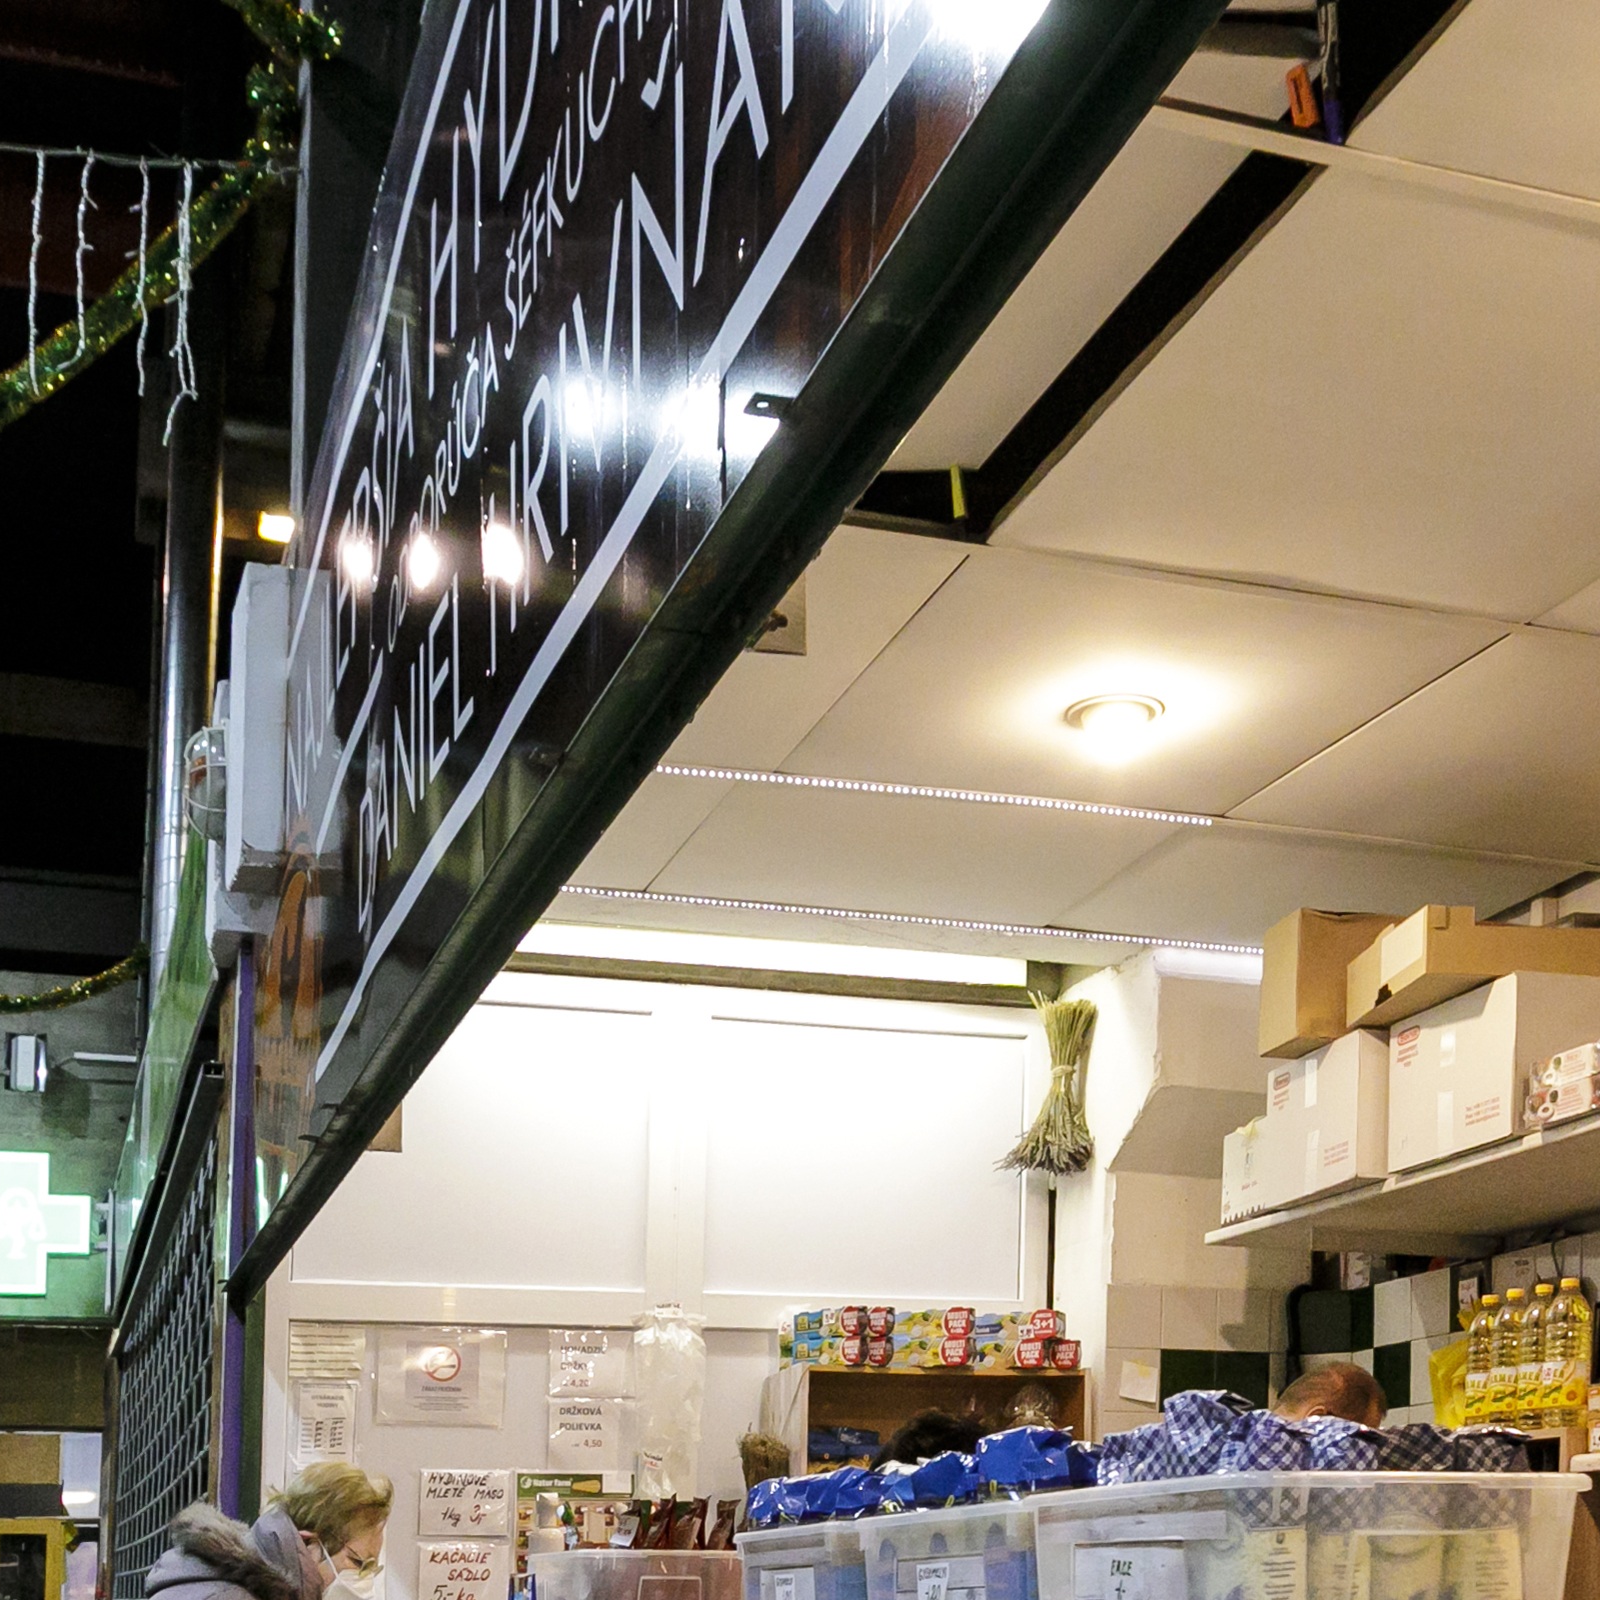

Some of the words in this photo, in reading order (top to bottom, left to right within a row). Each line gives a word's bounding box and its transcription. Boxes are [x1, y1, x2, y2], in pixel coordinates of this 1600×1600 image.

[428, 0, 560, 402] HYD
[503, 0, 652, 361] ŠÉFKUCH
[358, 570, 474, 932] DANIEL
[559, 1406, 603, 1416] DRŽKOVÁ
[559, 1422, 602, 1431] POLIEVKA
